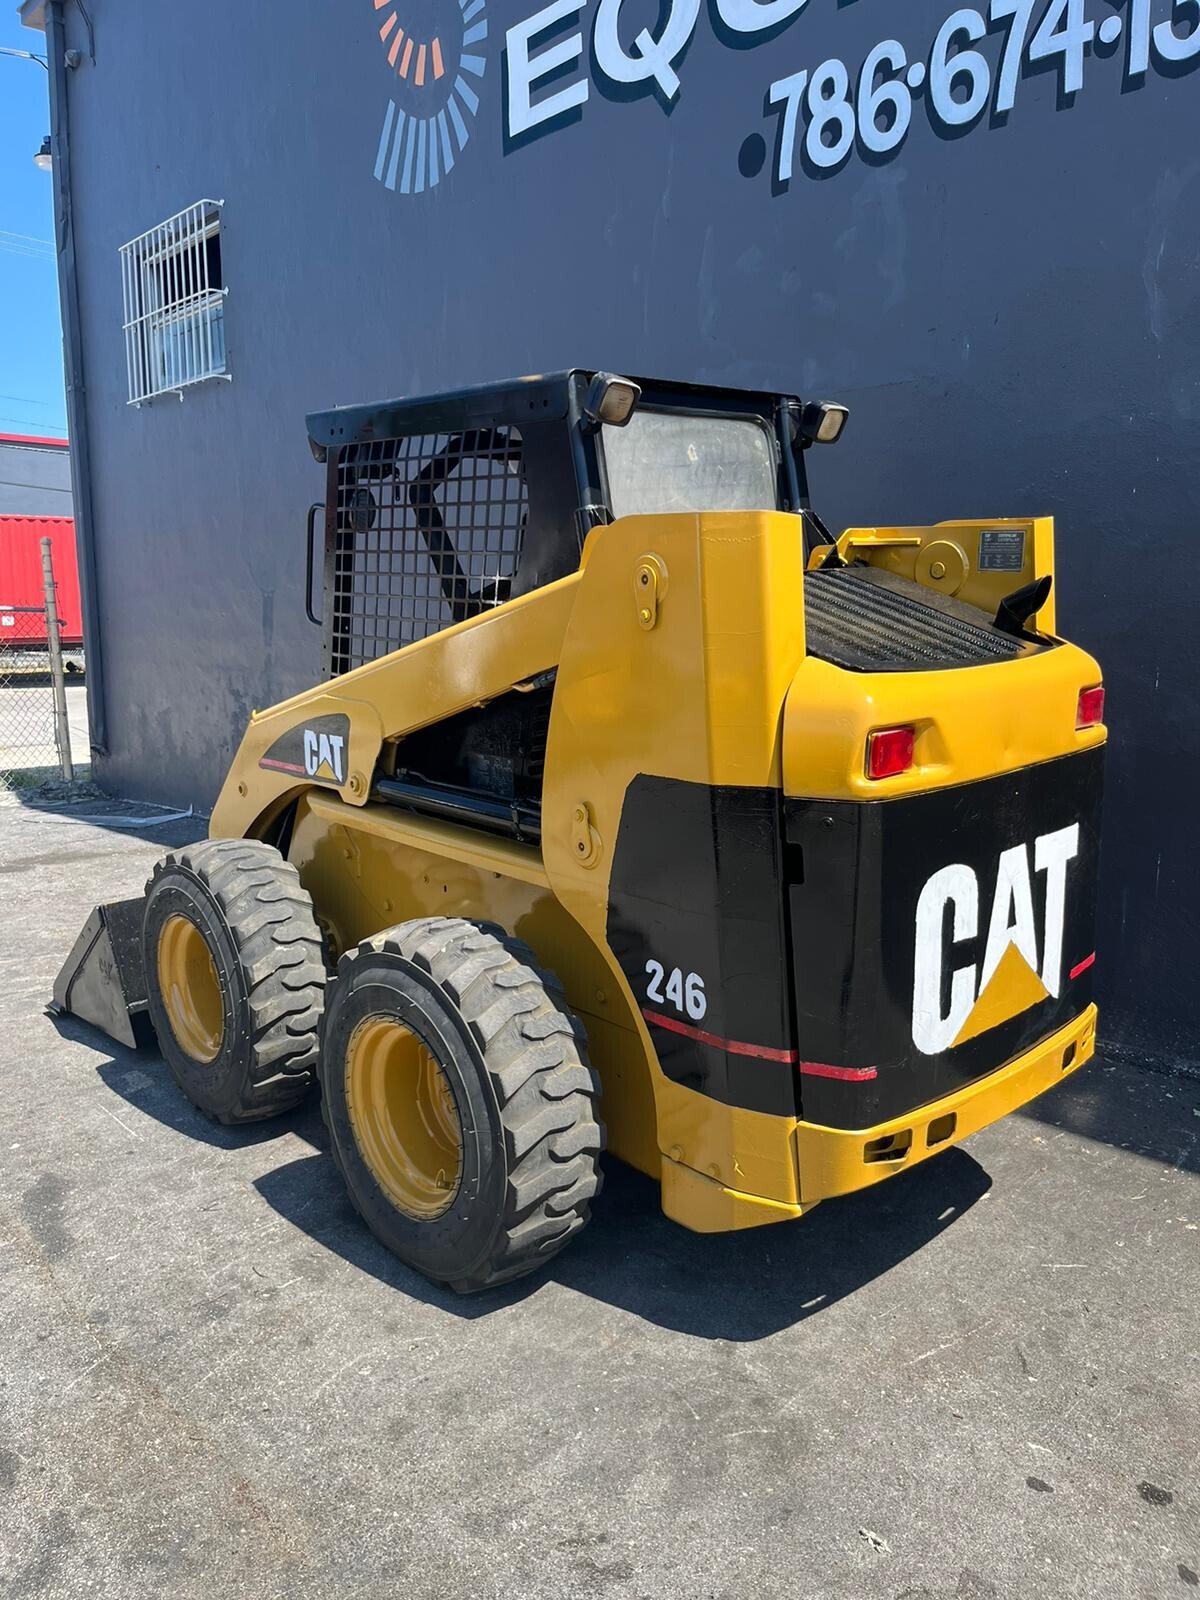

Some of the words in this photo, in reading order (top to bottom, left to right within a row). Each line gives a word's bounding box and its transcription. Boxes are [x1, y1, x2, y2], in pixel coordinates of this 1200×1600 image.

[505, 0, 810, 138] EQ
[303, 729, 344, 782] CAT
[912, 822, 1079, 1055] CAT
[645, 959, 707, 1020] 246
